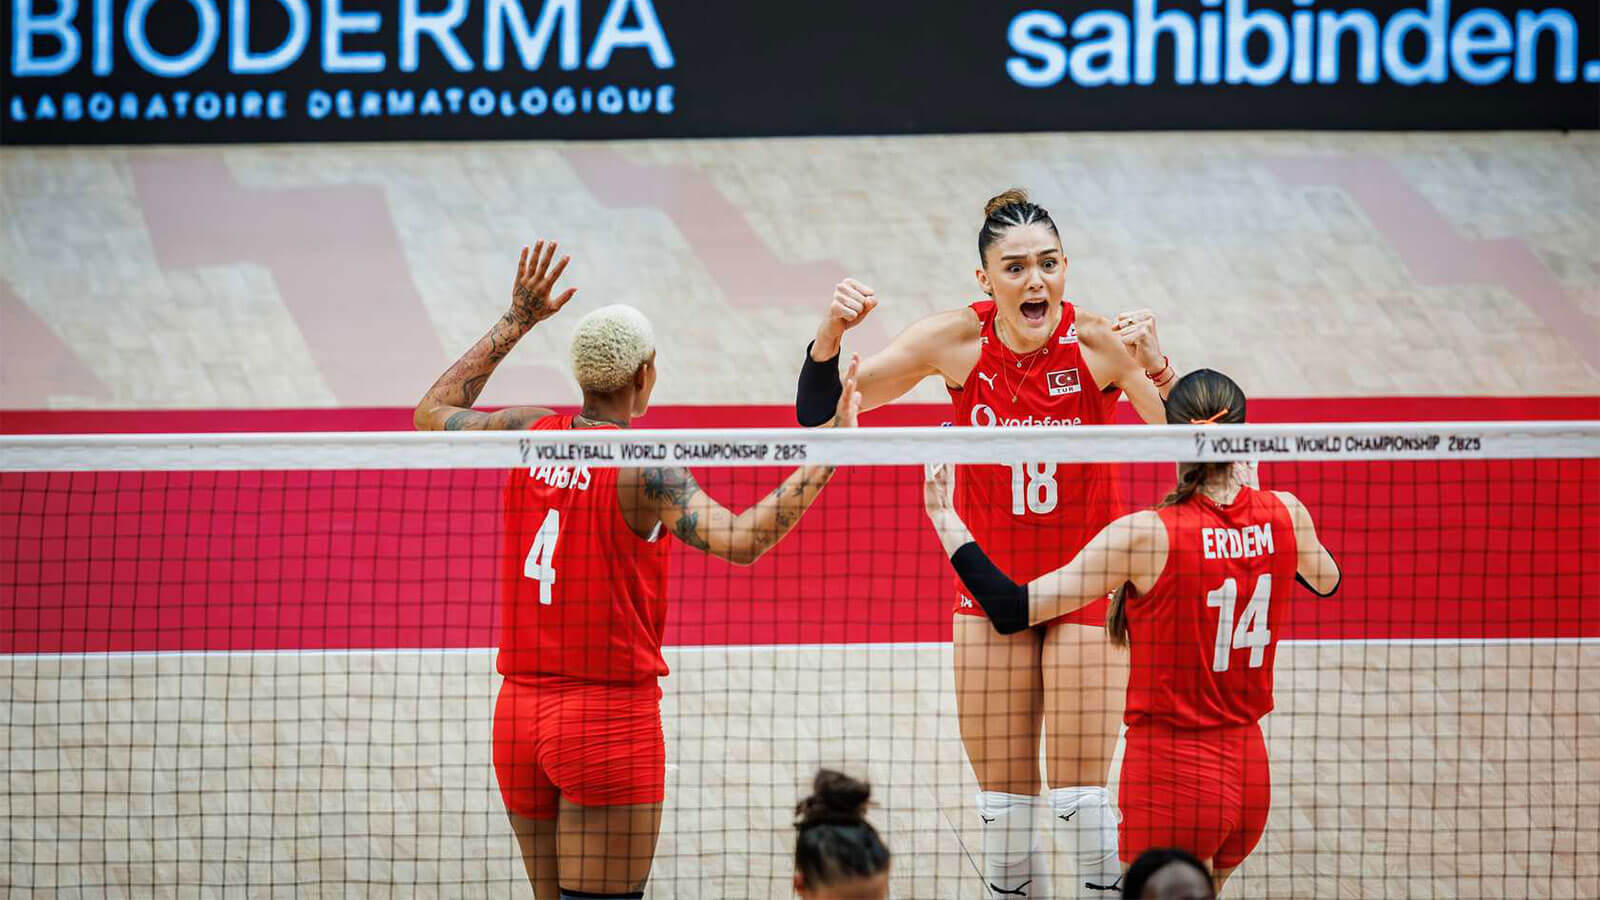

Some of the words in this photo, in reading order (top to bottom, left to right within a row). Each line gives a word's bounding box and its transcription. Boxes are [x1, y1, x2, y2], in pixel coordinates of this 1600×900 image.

[11, 0, 675, 78] BIODERMA
[11, 90, 286, 121] LABORATOIRE
[307, 85, 675, 118] DERMATOLOGIQUE
[536, 443, 615, 460] VOLLEYBALL
[621, 443, 667, 460] WORLD
[673, 443, 768, 460] CHAMPIONSHIP
[1211, 436, 1290, 453] VOLLEYBALL
[1296, 436, 1342, 453] WORLD
[1345, 435, 1440, 452] CHAMPIONSHIP
[1001, 462, 1058, 515] 18
[524, 508, 560, 605] 4
[1202, 523, 1275, 559] ERDEM
[1207, 573, 1272, 672] 14
